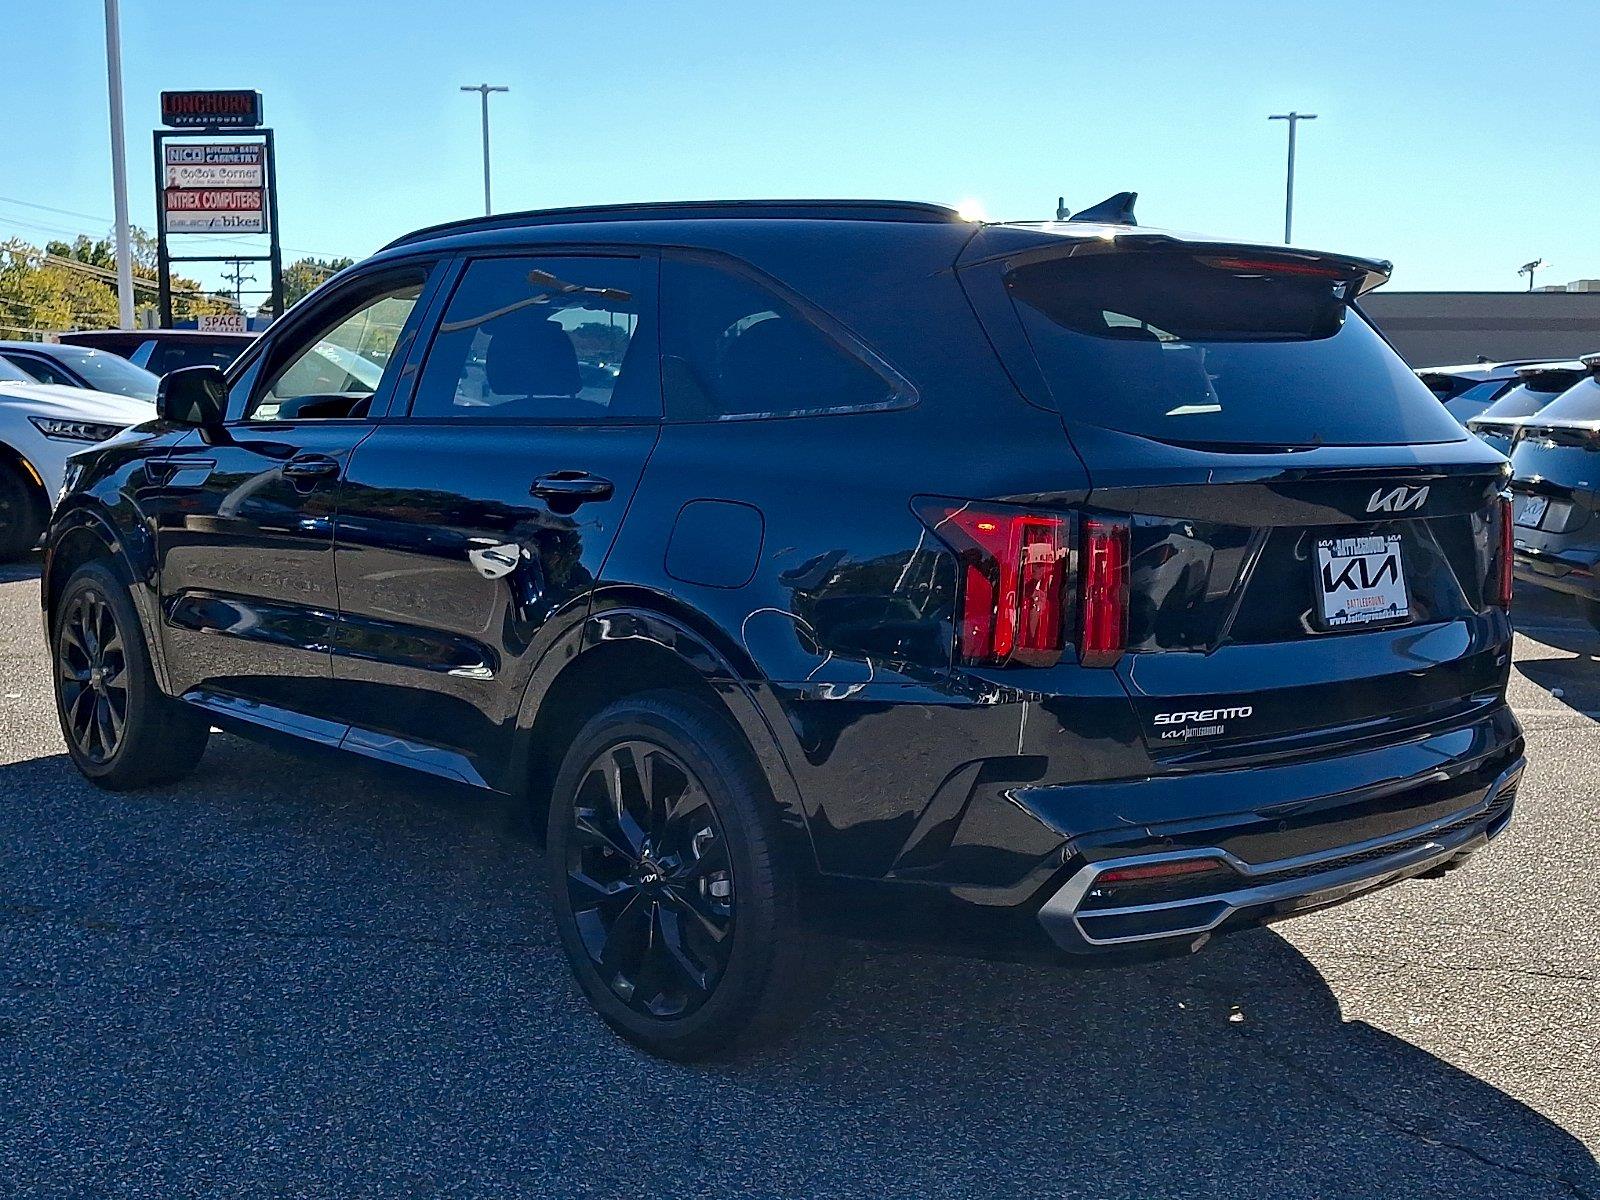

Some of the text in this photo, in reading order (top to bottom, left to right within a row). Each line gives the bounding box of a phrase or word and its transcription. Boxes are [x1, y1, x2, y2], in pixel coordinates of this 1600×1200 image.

[164, 94, 252, 114] LONGHORN
[219, 168, 258, 178] Corner
[167, 191, 260, 208] INTREX COMPUTERS
[221, 216, 260, 227] bikes
[205, 316, 241, 326] SPACE
[1322, 555, 1398, 593] KIA
[1153, 706, 1253, 725] SORENTO
